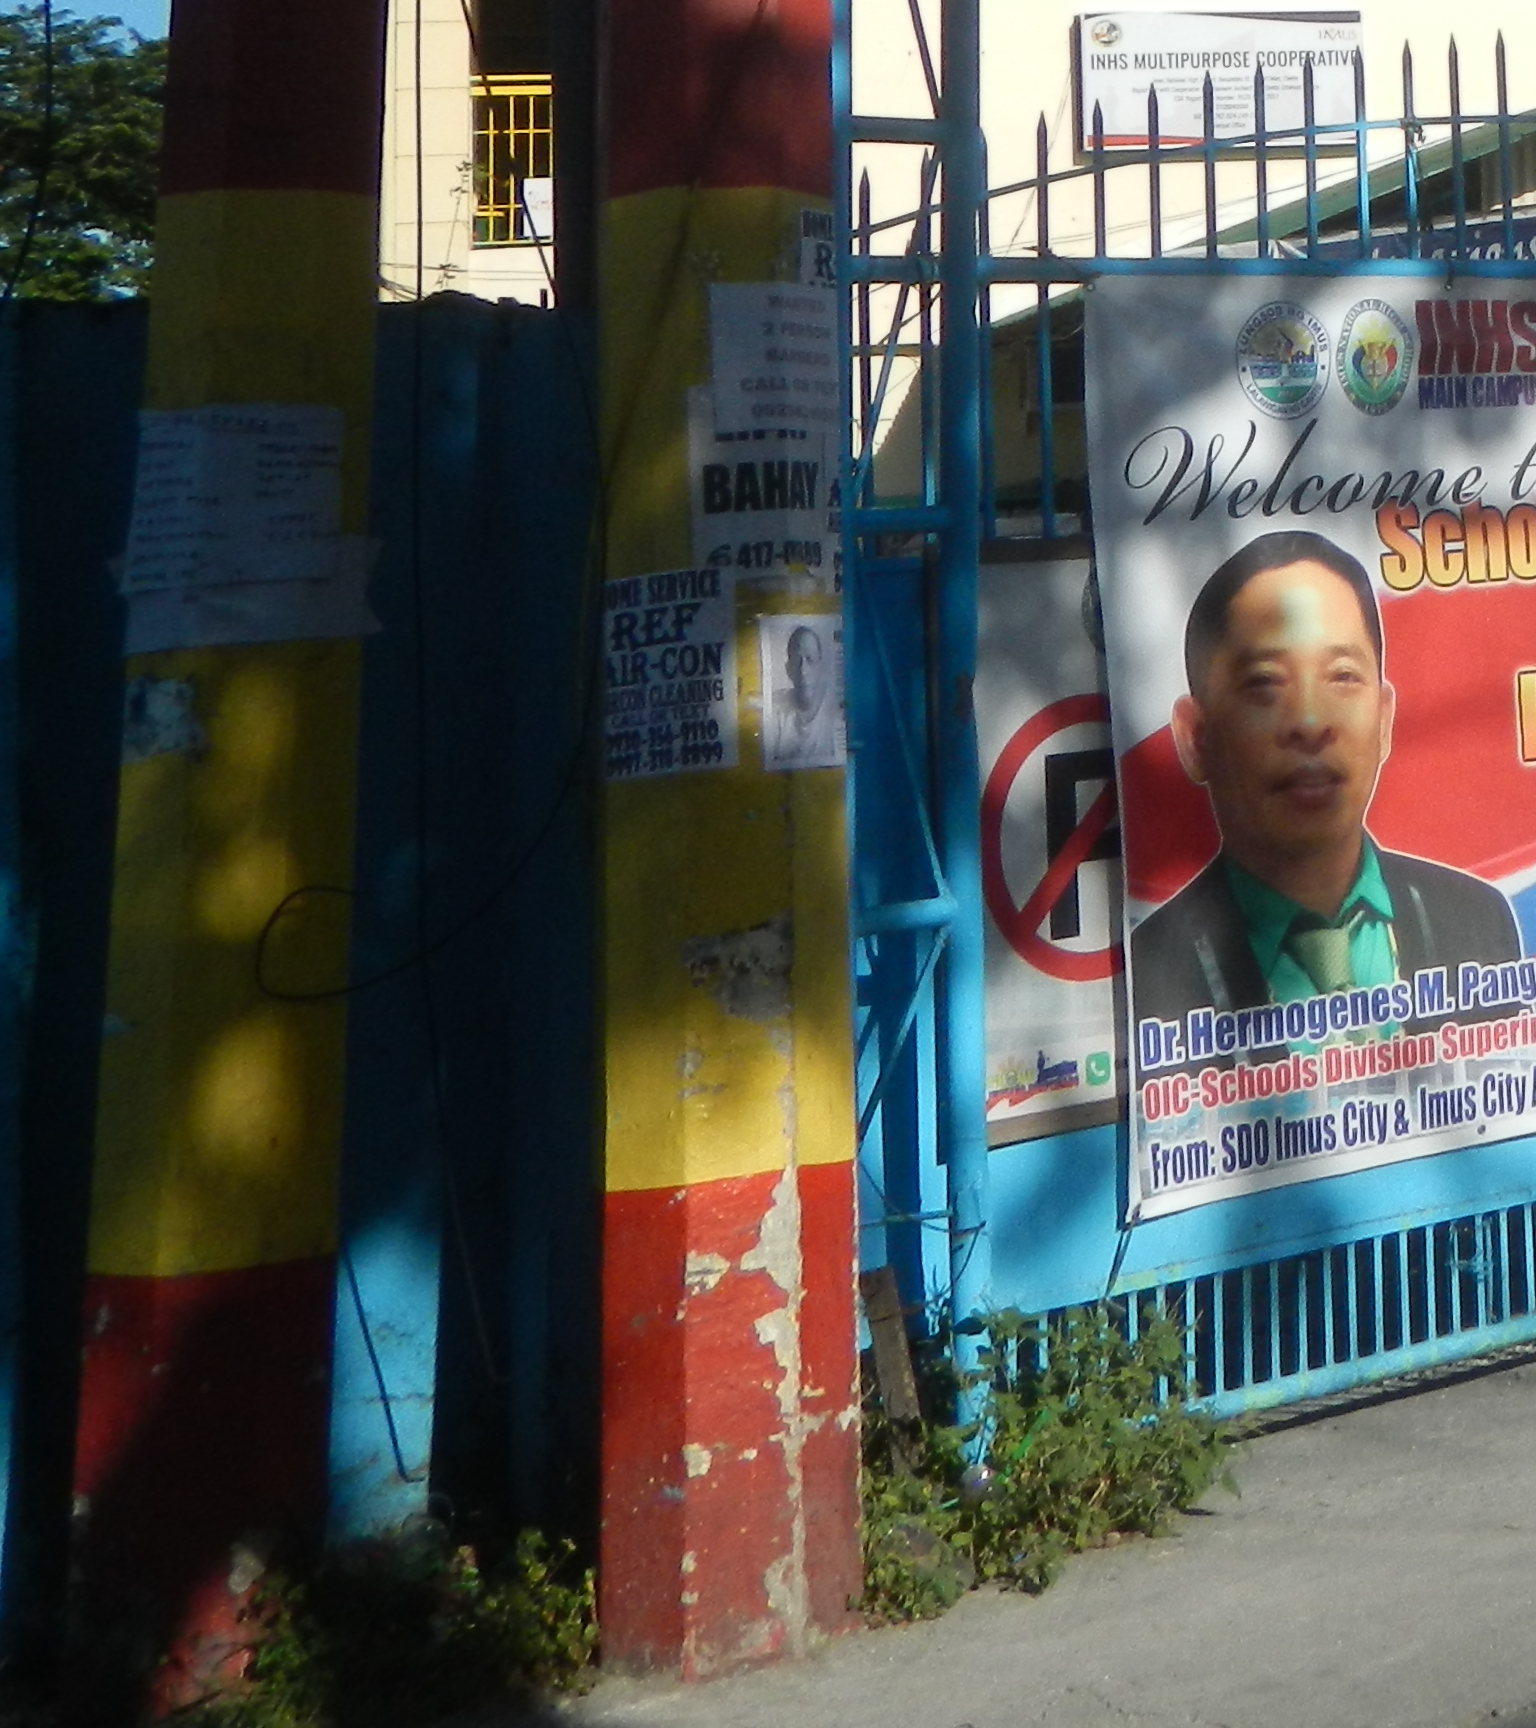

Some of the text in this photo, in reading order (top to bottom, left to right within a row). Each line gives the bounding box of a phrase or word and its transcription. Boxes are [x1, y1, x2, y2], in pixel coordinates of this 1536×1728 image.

[1090, 53, 1128, 71] INHS
[1134, 51, 1250, 70] MULTIPURPOSE
[1307, 317, 1328, 353] IMUS
[1418, 374, 1468, 410] MAIN
[702, 460, 819, 515] BAHAY
[1124, 418, 1488, 526] Welcome
[610, 602, 702, 652] REF
[1140, 1020, 1185, 1069] Dr.
[1189, 982, 1411, 1057] Hermogenes
[1417, 970, 1454, 1015] M.
[1142, 1055, 1320, 1122] OIC-Schools
[1324, 1035, 1437, 1086] Division
[1150, 1136, 1217, 1192] From:
[1220, 1124, 1271, 1174] SDO
[1275, 1111, 1338, 1161] Imus
[1341, 1101, 1390, 1147] City
[1393, 1099, 1411, 1134] &
[1419, 1085, 1478, 1132] Imus
[1481, 1070, 1527, 1118] City
